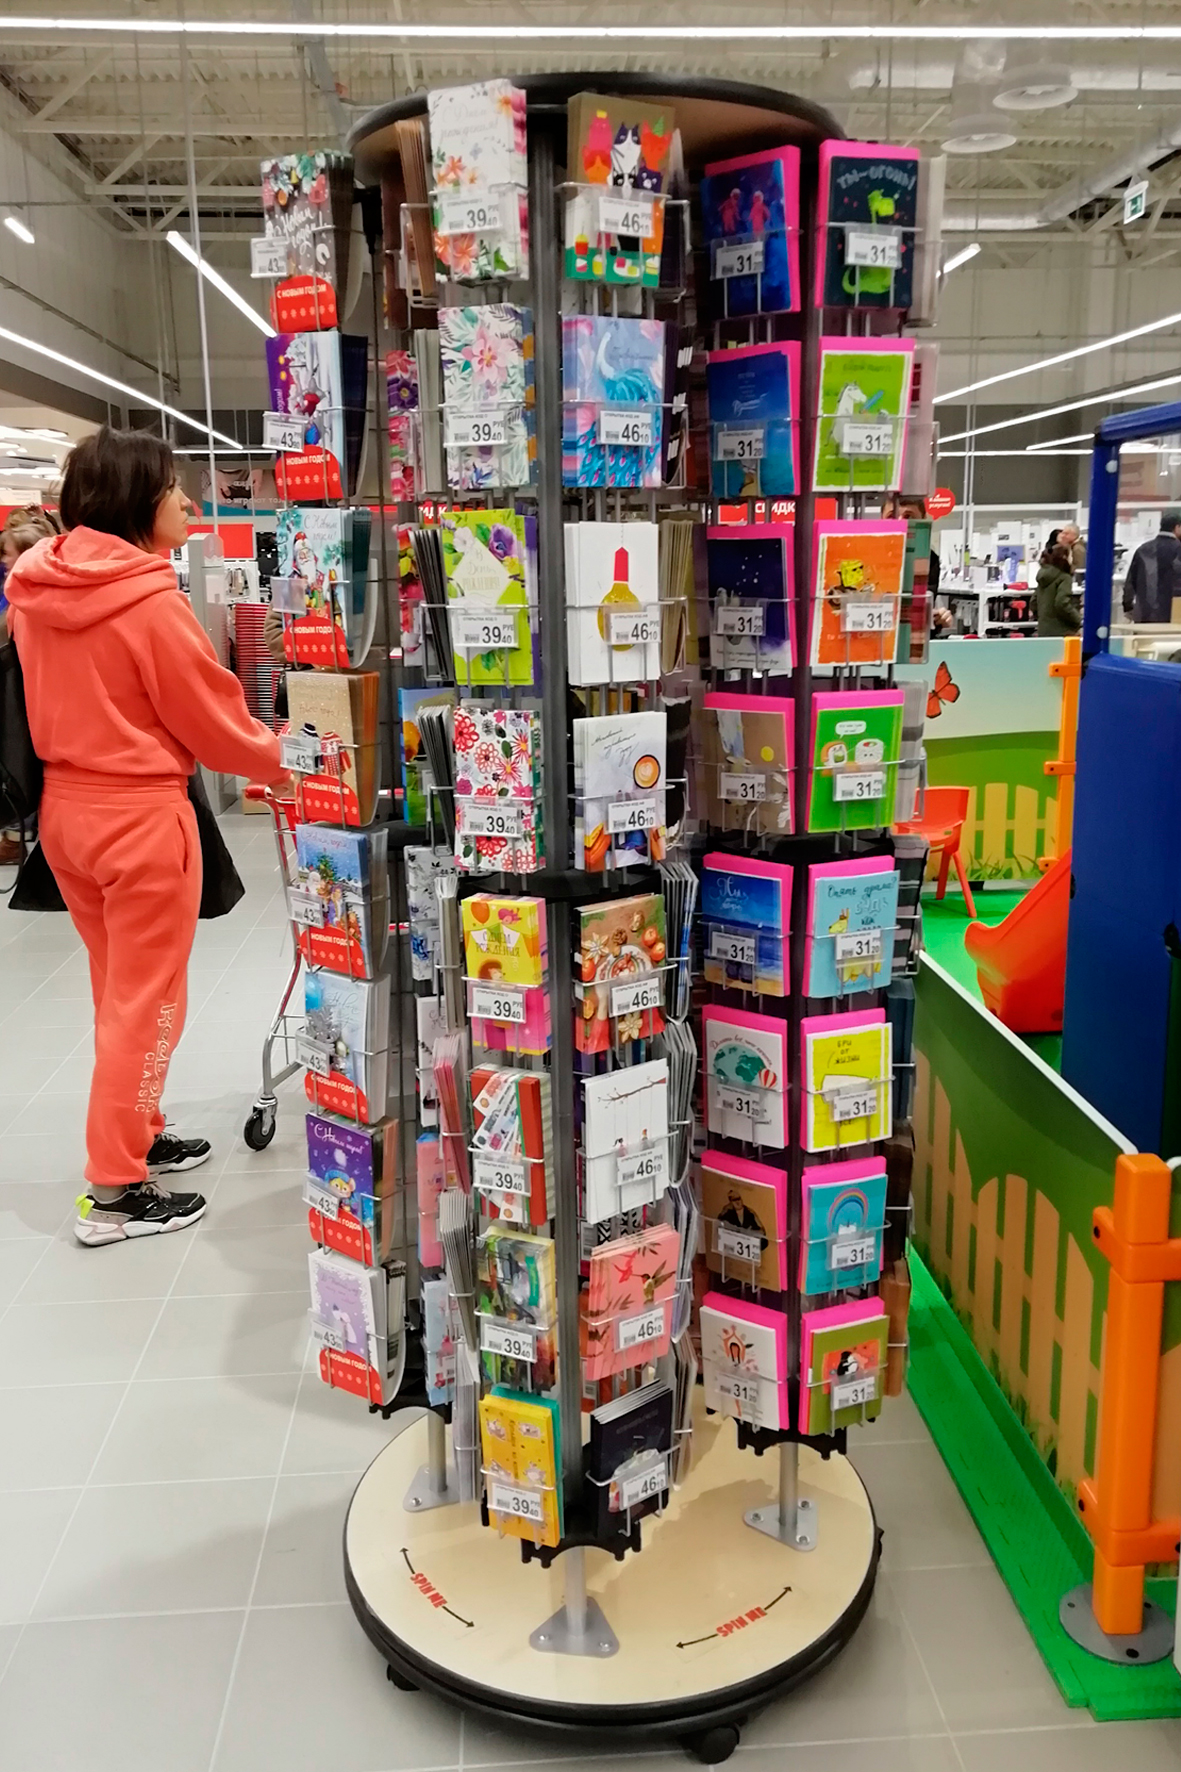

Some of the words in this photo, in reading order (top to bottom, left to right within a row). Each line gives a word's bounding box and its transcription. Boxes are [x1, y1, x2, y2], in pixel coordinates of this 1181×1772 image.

[467, 208, 487, 229] 39
[622, 211, 640, 233] 46
[736, 253, 752, 272] 31
[870, 244, 886, 264] 31
[268, 257, 280, 273] 43
[277, 290, 282, 298] С
[282, 287, 304, 297] НОВЫМ
[281, 432, 294, 448] 43
[472, 423, 491, 442] 39
[622, 423, 640, 442] 46
[640, 433, 650, 443] 10
[738, 440, 752, 458] 31
[865, 434, 881, 452] 31
[286, 456, 308, 466] НОВЫМ
[738, 616, 752, 633] 31
[867, 612, 882, 629] 31
[316, 626, 332, 634] ГОДО
[482, 626, 502, 644] 39
[631, 623, 649, 641] 46
[649, 631, 658, 640] 10
[296, 754, 306, 770] 43
[303, 780, 307, 788] С
[307, 781, 328, 792] НОВЫМ
[328, 784, 350, 794] ГОДМ
[740, 782, 755, 798] 31
[856, 780, 871, 797] 31
[486, 816, 505, 834] 39
[628, 810, 646, 828] 46
[645, 816, 654, 826] 10
[304, 908, 315, 922] 43
[310, 932, 332, 942] НОВЫМ
[730, 944, 744, 960] 31
[856, 939, 870, 956] 31
[632, 990, 649, 1008] 46
[494, 1000, 512, 1018] 39
[310, 1054, 321, 1070] 43
[134, 1052, 155, 1113] CLASSIC
[338, 1082, 356, 1094] ГОДО
[736, 1097, 750, 1114] 31
[852, 1100, 867, 1116] 31
[636, 1159, 654, 1176] 46
[495, 1171, 514, 1190] 39
[318, 1196, 330, 1212] 43
[736, 1241, 750, 1258] 31
[850, 1248, 864, 1262] 31
[638, 1320, 654, 1338] 46
[324, 1332, 336, 1346] 43
[504, 1338, 522, 1356] 39
[330, 1352, 351, 1364] НОВЫМ
[351, 1359, 368, 1370] ГОДО
[734, 1383, 748, 1400] 31
[852, 1388, 866, 1402] 31
[641, 1476, 656, 1494] 46
[512, 1496, 530, 1514] 39
[410, 1572, 436, 1595] SPIN
[427, 1592, 448, 1608] ME
[716, 1616, 748, 1638] SPIN
[745, 1606, 768, 1622] ME
